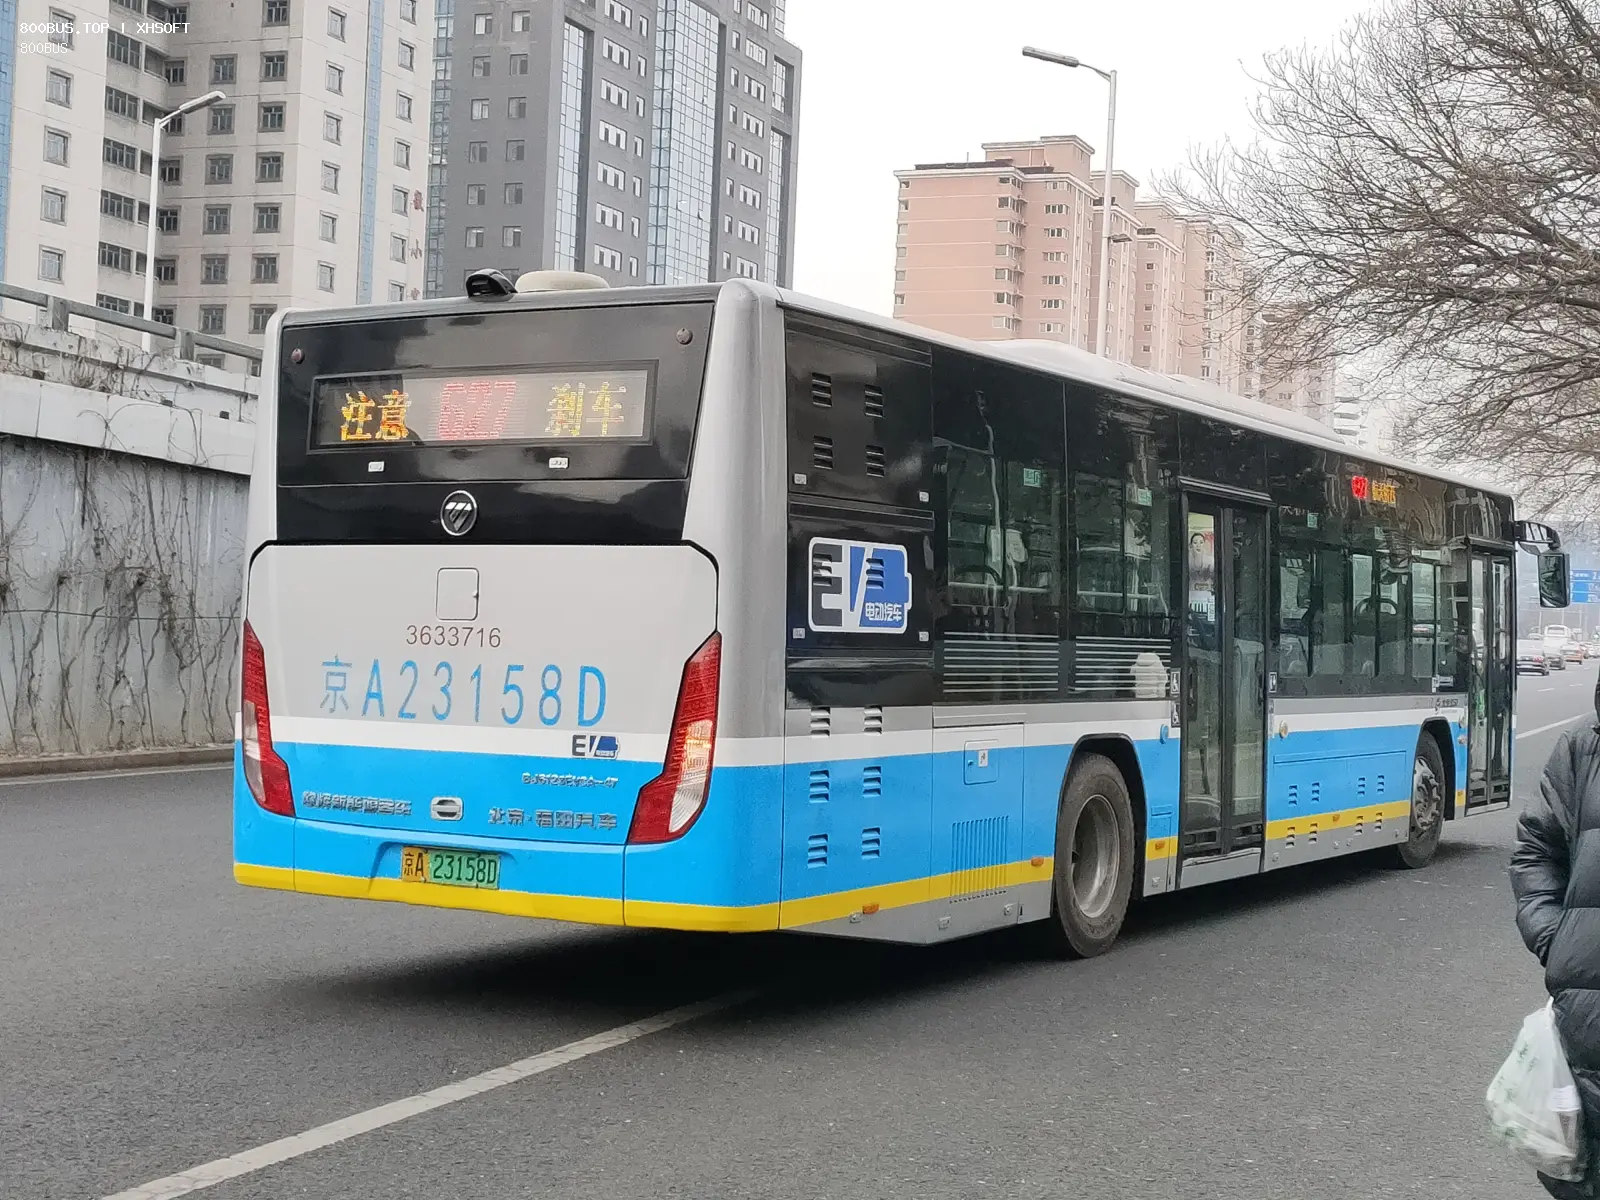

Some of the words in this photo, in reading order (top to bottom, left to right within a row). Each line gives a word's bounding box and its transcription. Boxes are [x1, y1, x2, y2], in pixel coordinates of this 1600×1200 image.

[340, 390, 411, 442] 注意
[865, 602, 902, 622] 电动汽车
[405, 624, 502, 648] 3633716
[319, 653, 607, 727] 京A23158D
